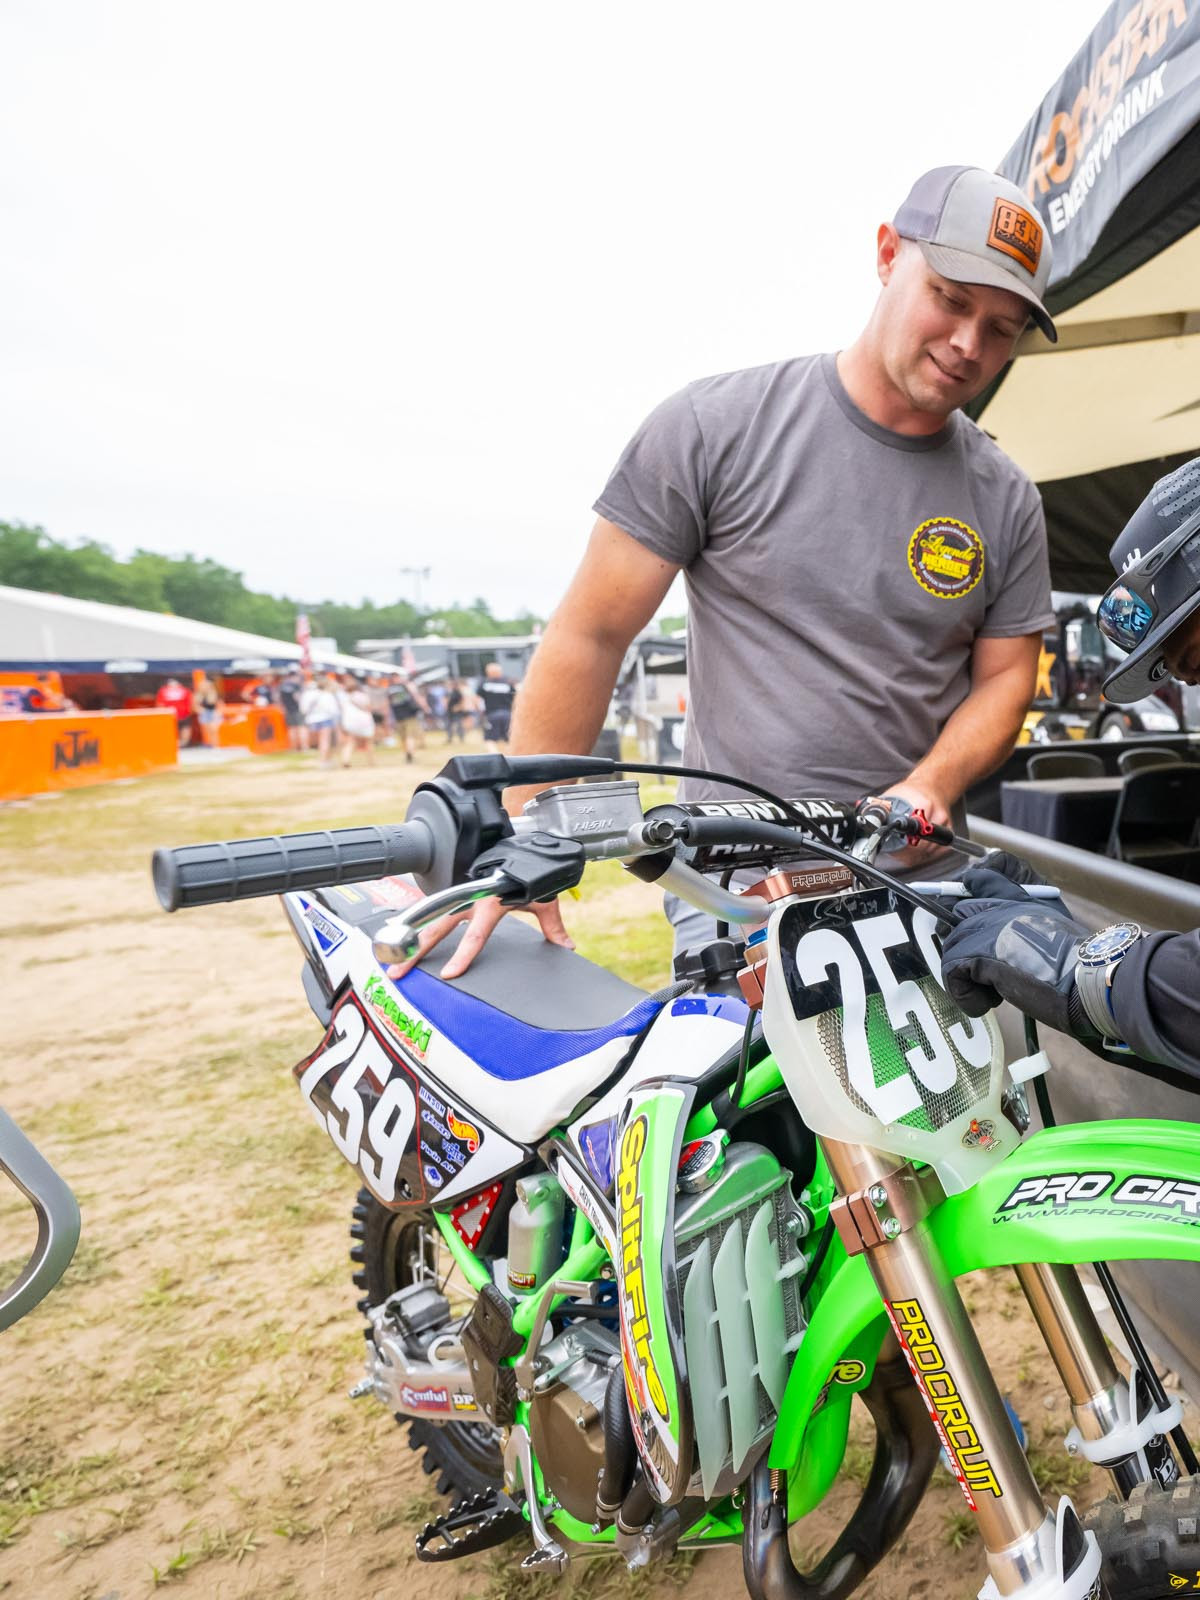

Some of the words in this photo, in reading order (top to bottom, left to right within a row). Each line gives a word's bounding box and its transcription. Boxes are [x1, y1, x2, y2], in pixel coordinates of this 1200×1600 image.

[1048, 134, 1103, 235] ENERGY
[1101, 60, 1168, 160] DRINK
[54, 730, 100, 770] KTM
[299, 1003, 417, 1202] 259
[618, 1116, 670, 1423] SplitFire
[1003, 1174, 1113, 1210] PRO
[891, 1298, 945, 1372] PRO
[923, 1371, 1003, 1498] CIRCUIT
[957, 1478, 977, 1508] KIT
